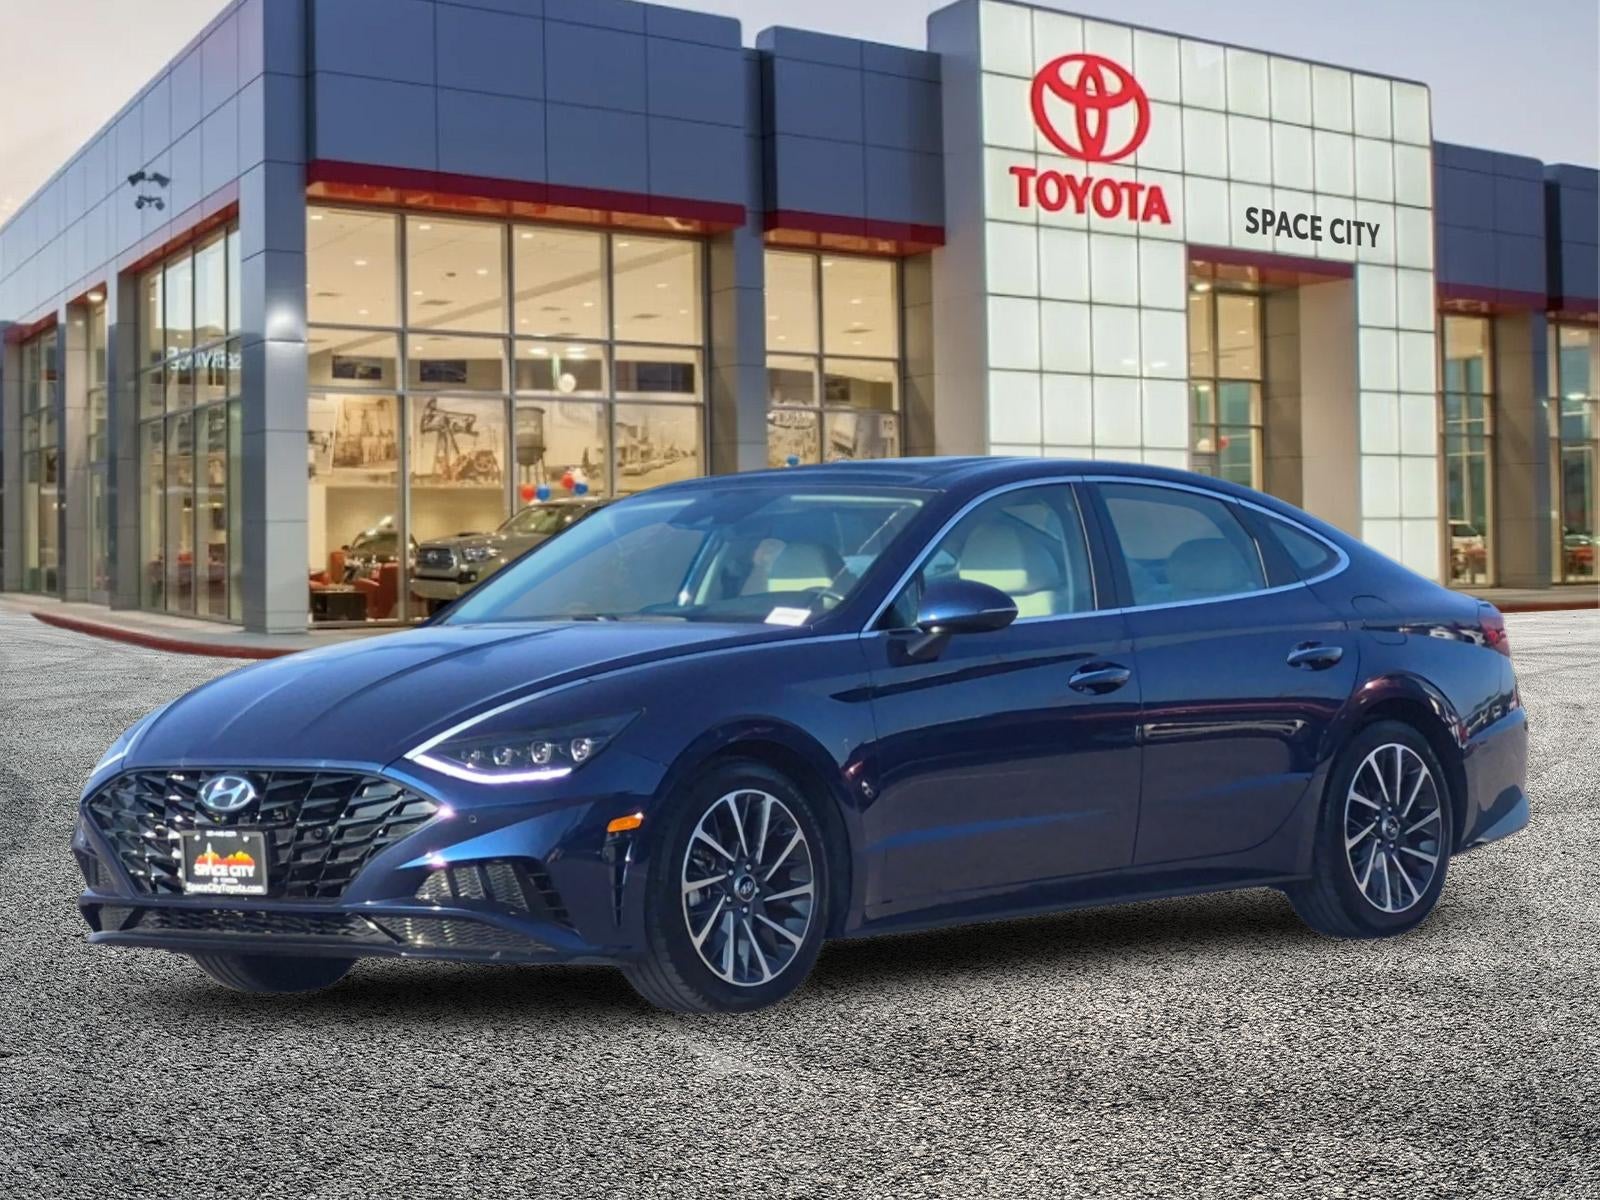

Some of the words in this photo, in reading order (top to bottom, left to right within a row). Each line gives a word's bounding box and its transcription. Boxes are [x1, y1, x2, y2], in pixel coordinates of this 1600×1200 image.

[1009, 166, 1171, 224] TOYOTA
[1245, 206, 1322, 242] SPACE
[1329, 218, 1381, 248] CITY
[193, 863, 229, 877] SPACE
[229, 865, 256, 878] CITY
